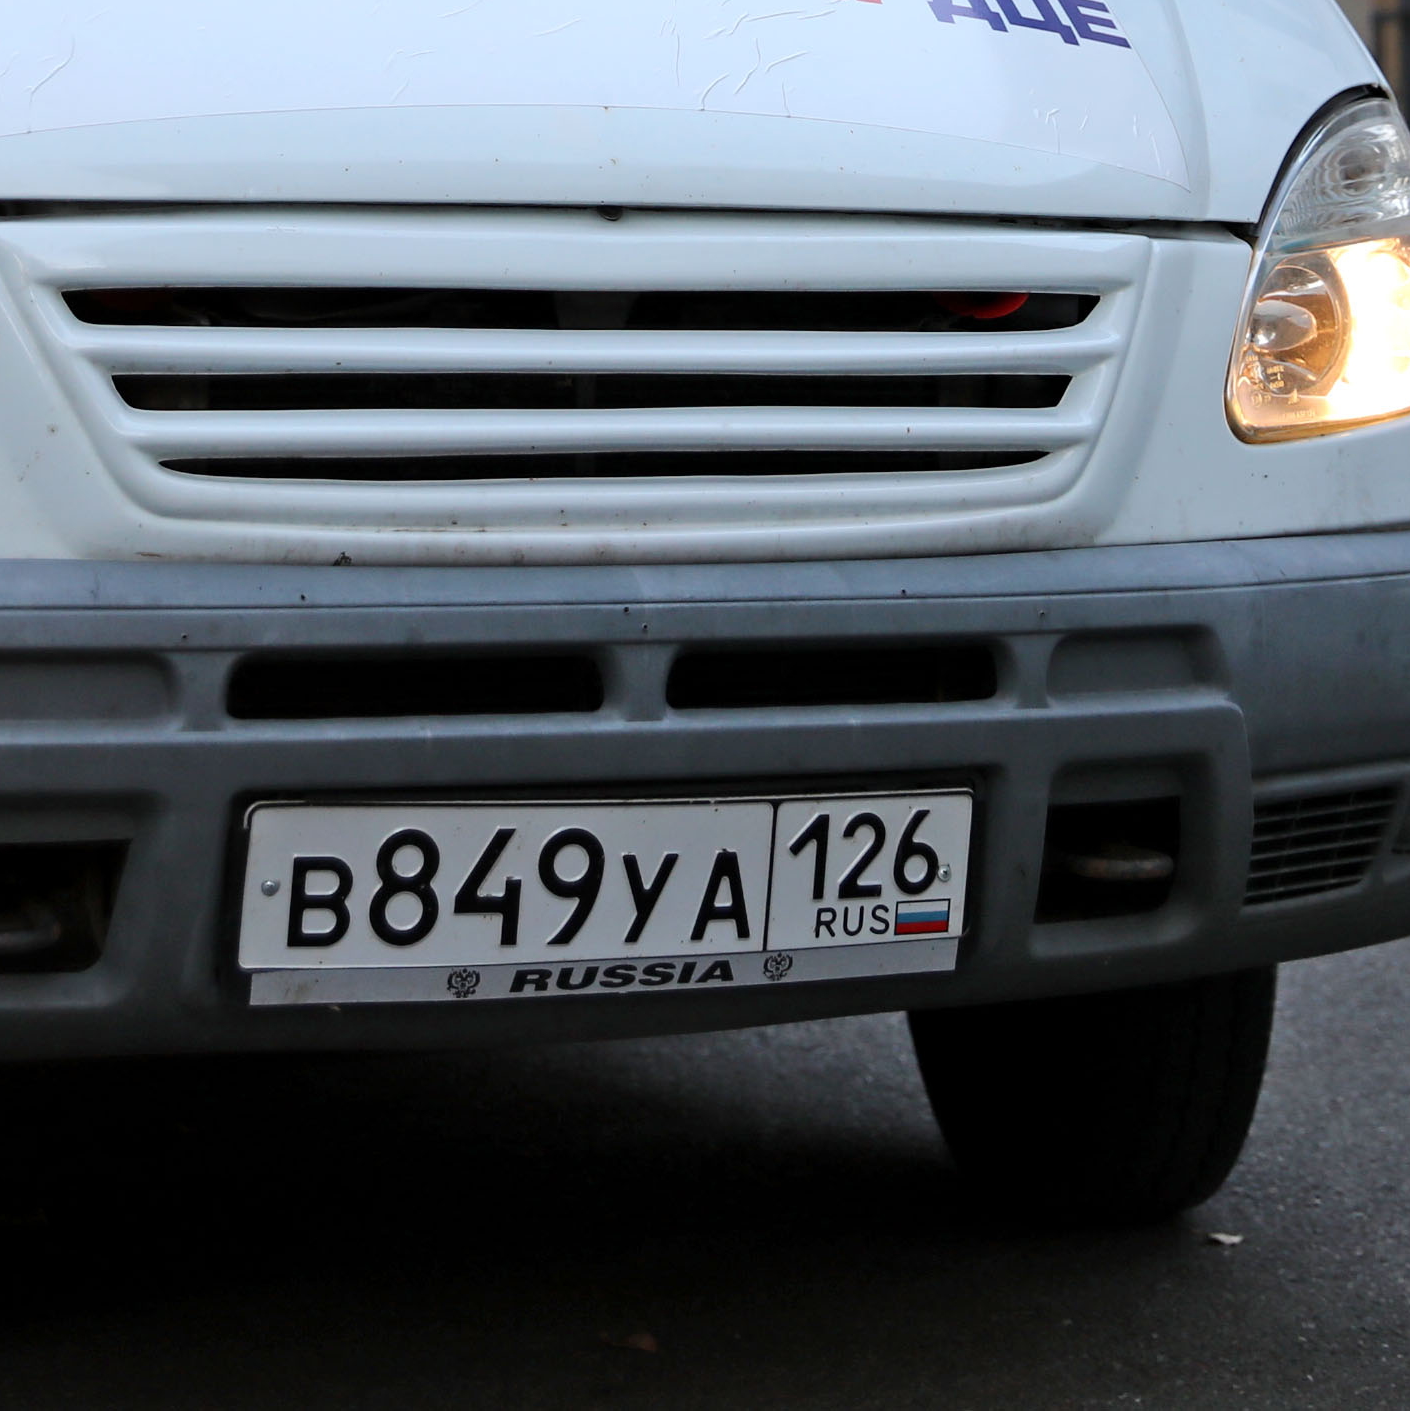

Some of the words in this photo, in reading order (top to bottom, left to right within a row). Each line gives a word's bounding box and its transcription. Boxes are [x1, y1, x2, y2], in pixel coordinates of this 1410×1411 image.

[287, 828, 750, 948] В849УА
[789, 809, 939, 900] 126
[815, 904, 890, 939] RUS
[508, 959, 735, 993] RUSSIA
